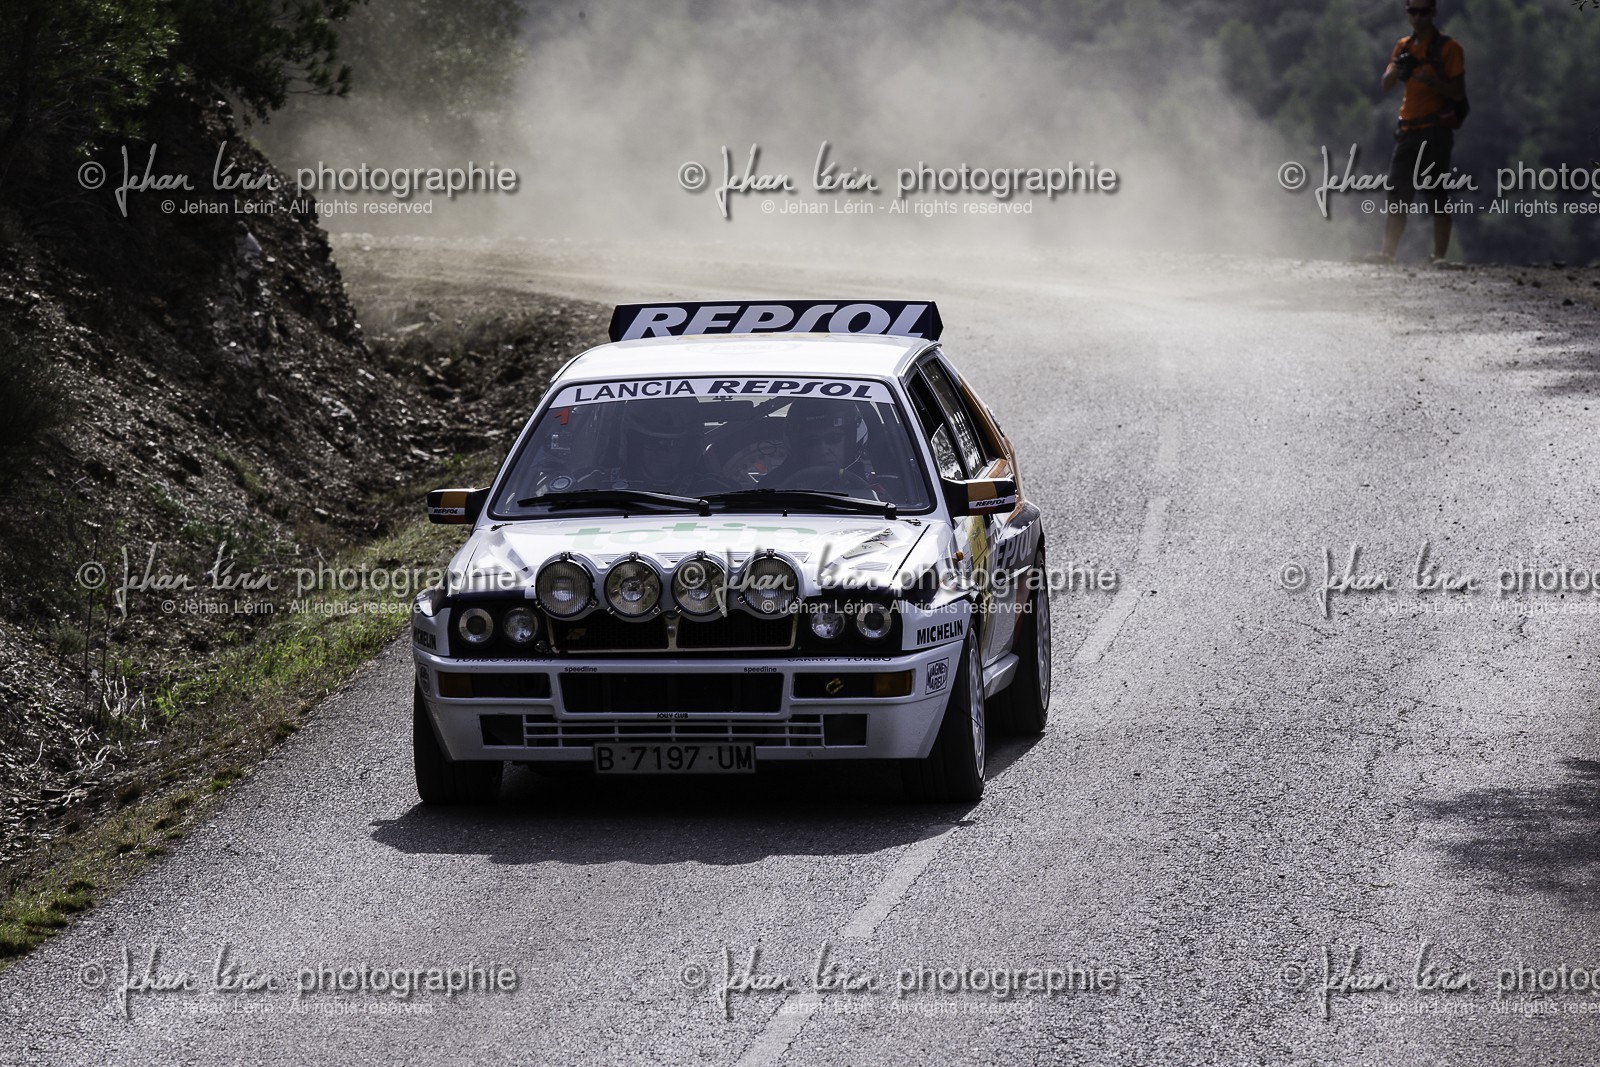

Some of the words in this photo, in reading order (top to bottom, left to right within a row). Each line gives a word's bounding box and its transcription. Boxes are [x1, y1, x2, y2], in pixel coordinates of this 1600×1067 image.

[621, 303, 931, 341] REPSOL
[575, 380, 695, 402] LANCIA
[707, 380, 872, 399] REPSOL
[554, 407, 570, 425] 1
[975, 498, 1006, 507] REPSOL
[564, 522, 819, 550] totip
[916, 619, 963, 646] MICHELIN
